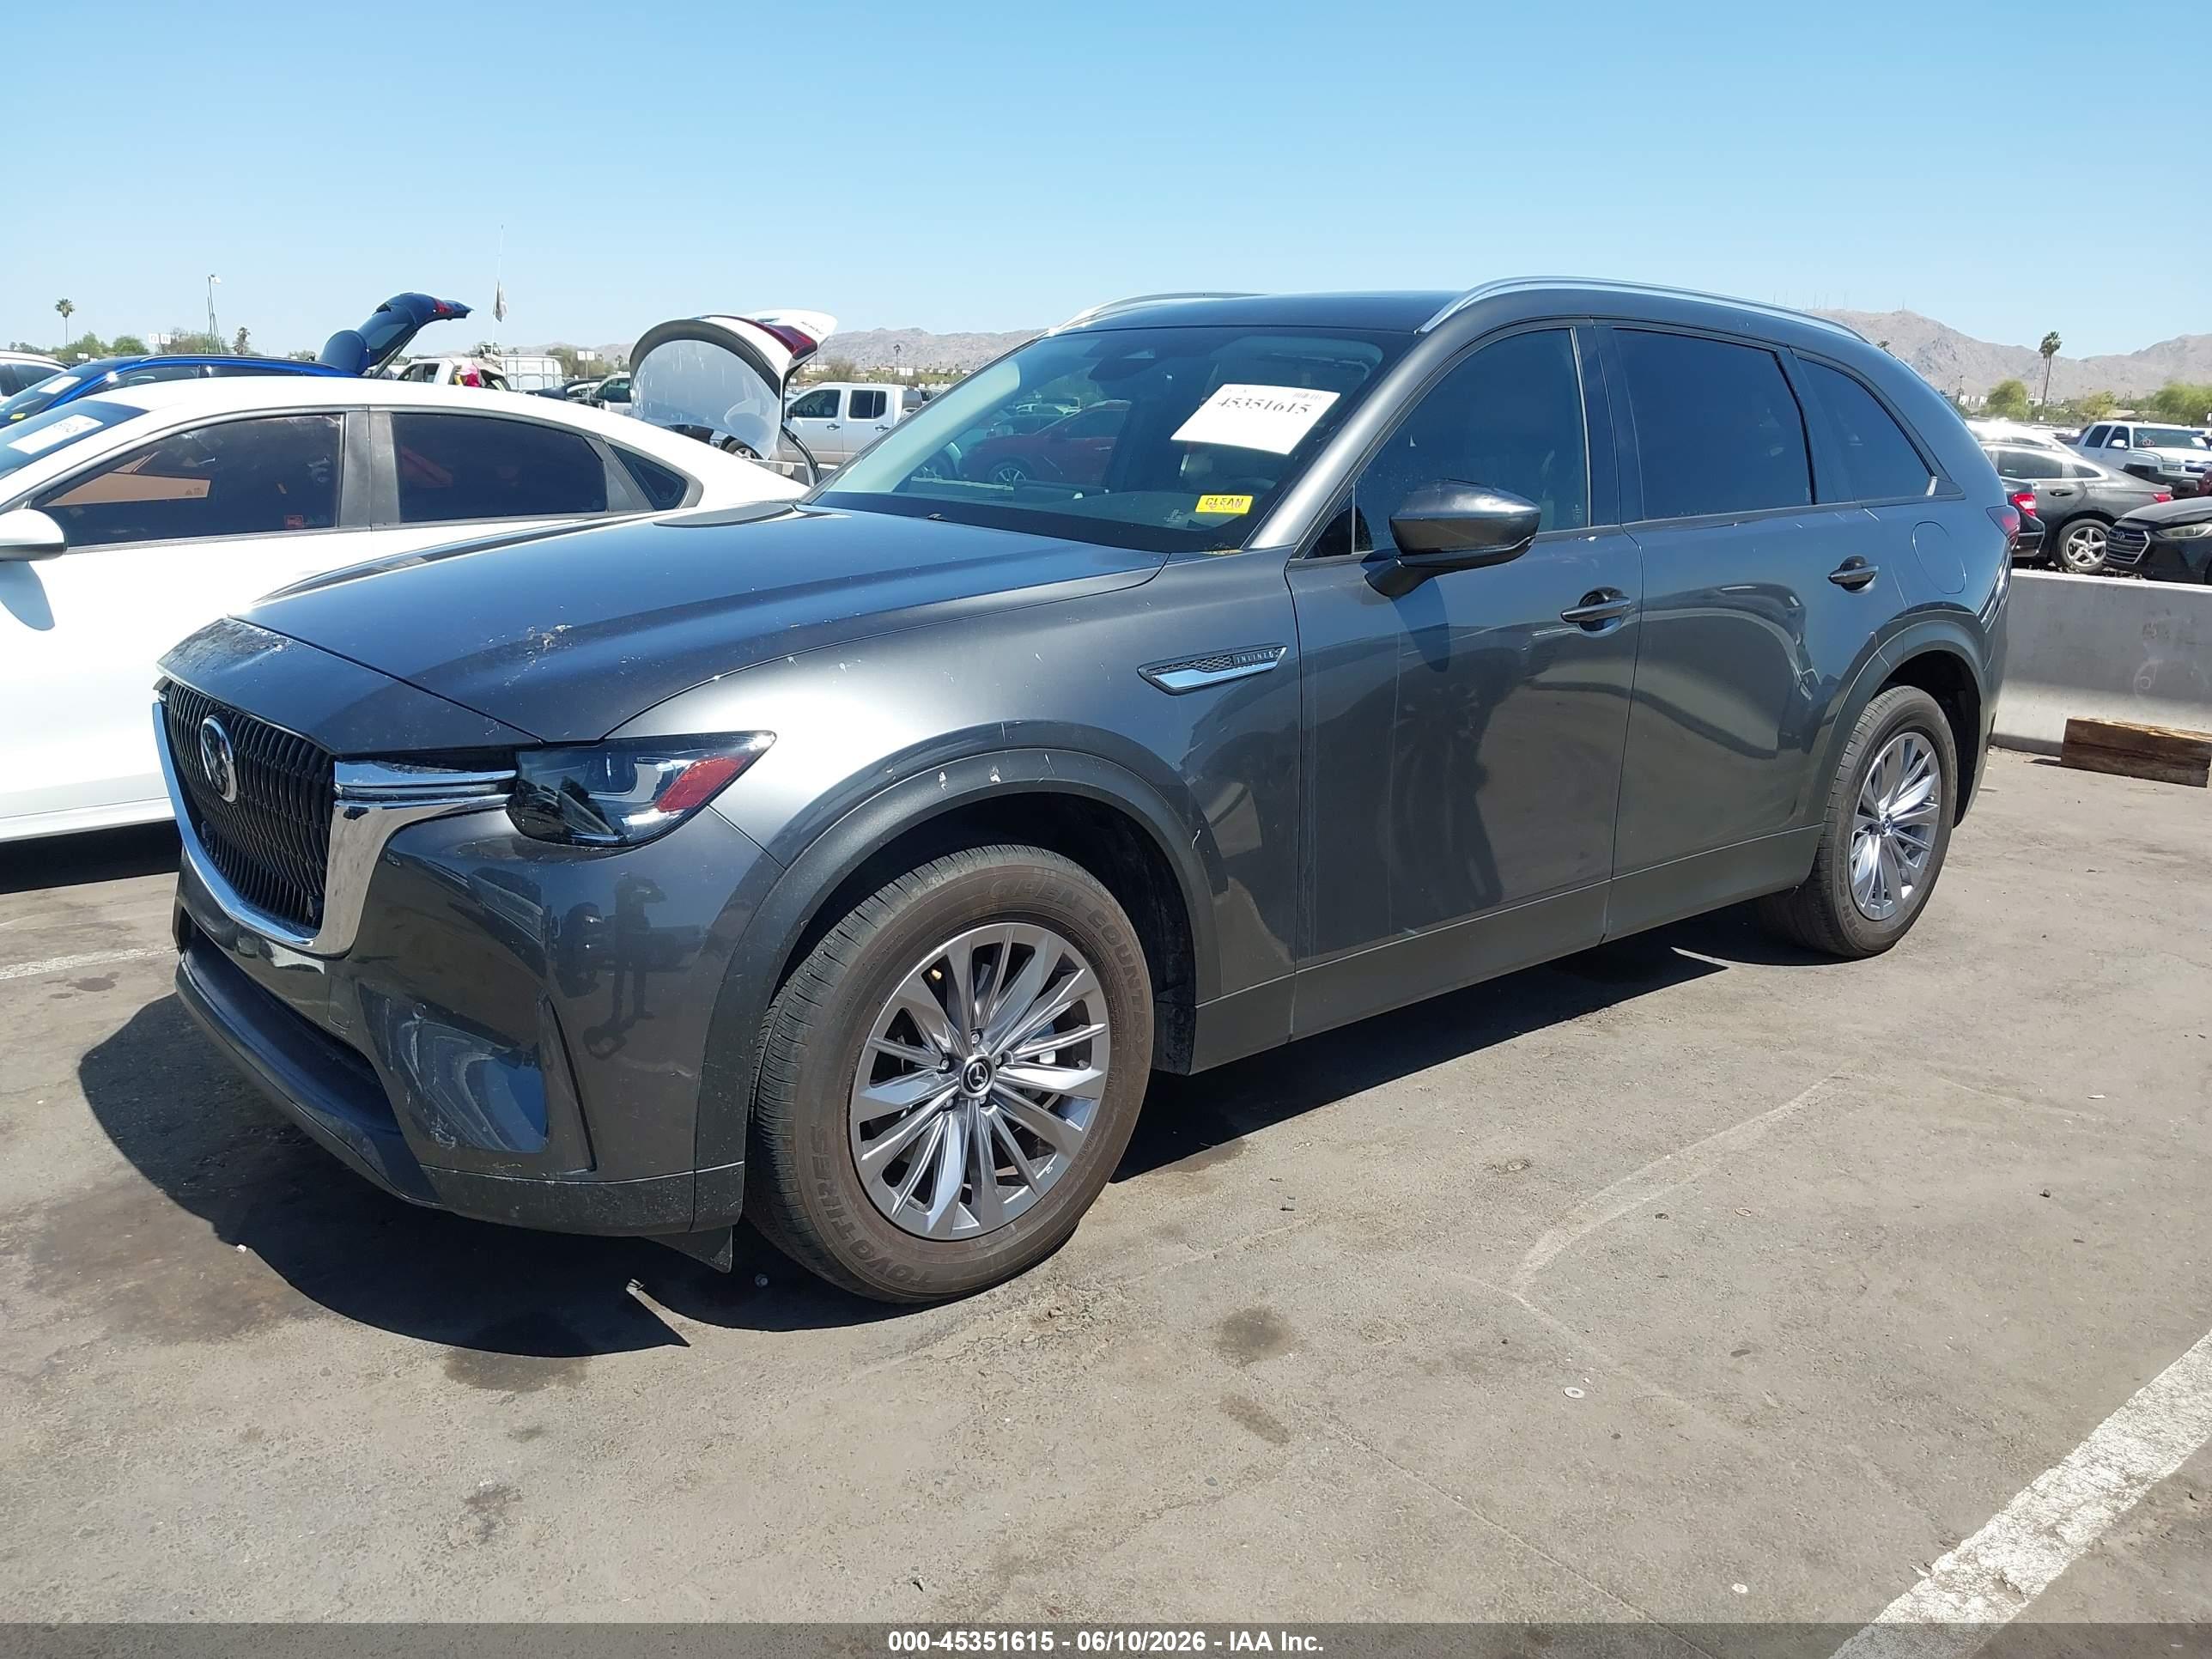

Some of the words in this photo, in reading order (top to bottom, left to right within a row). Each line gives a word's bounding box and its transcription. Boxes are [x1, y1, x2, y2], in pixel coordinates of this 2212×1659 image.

[1218, 398, 1311, 414] 45351615
[1205, 497, 1244, 507] CLEAN
[988, 878, 1084, 904] OPEN
[811, 1124, 857, 1241] TIRES
[849, 1239, 934, 1287] TOYO
